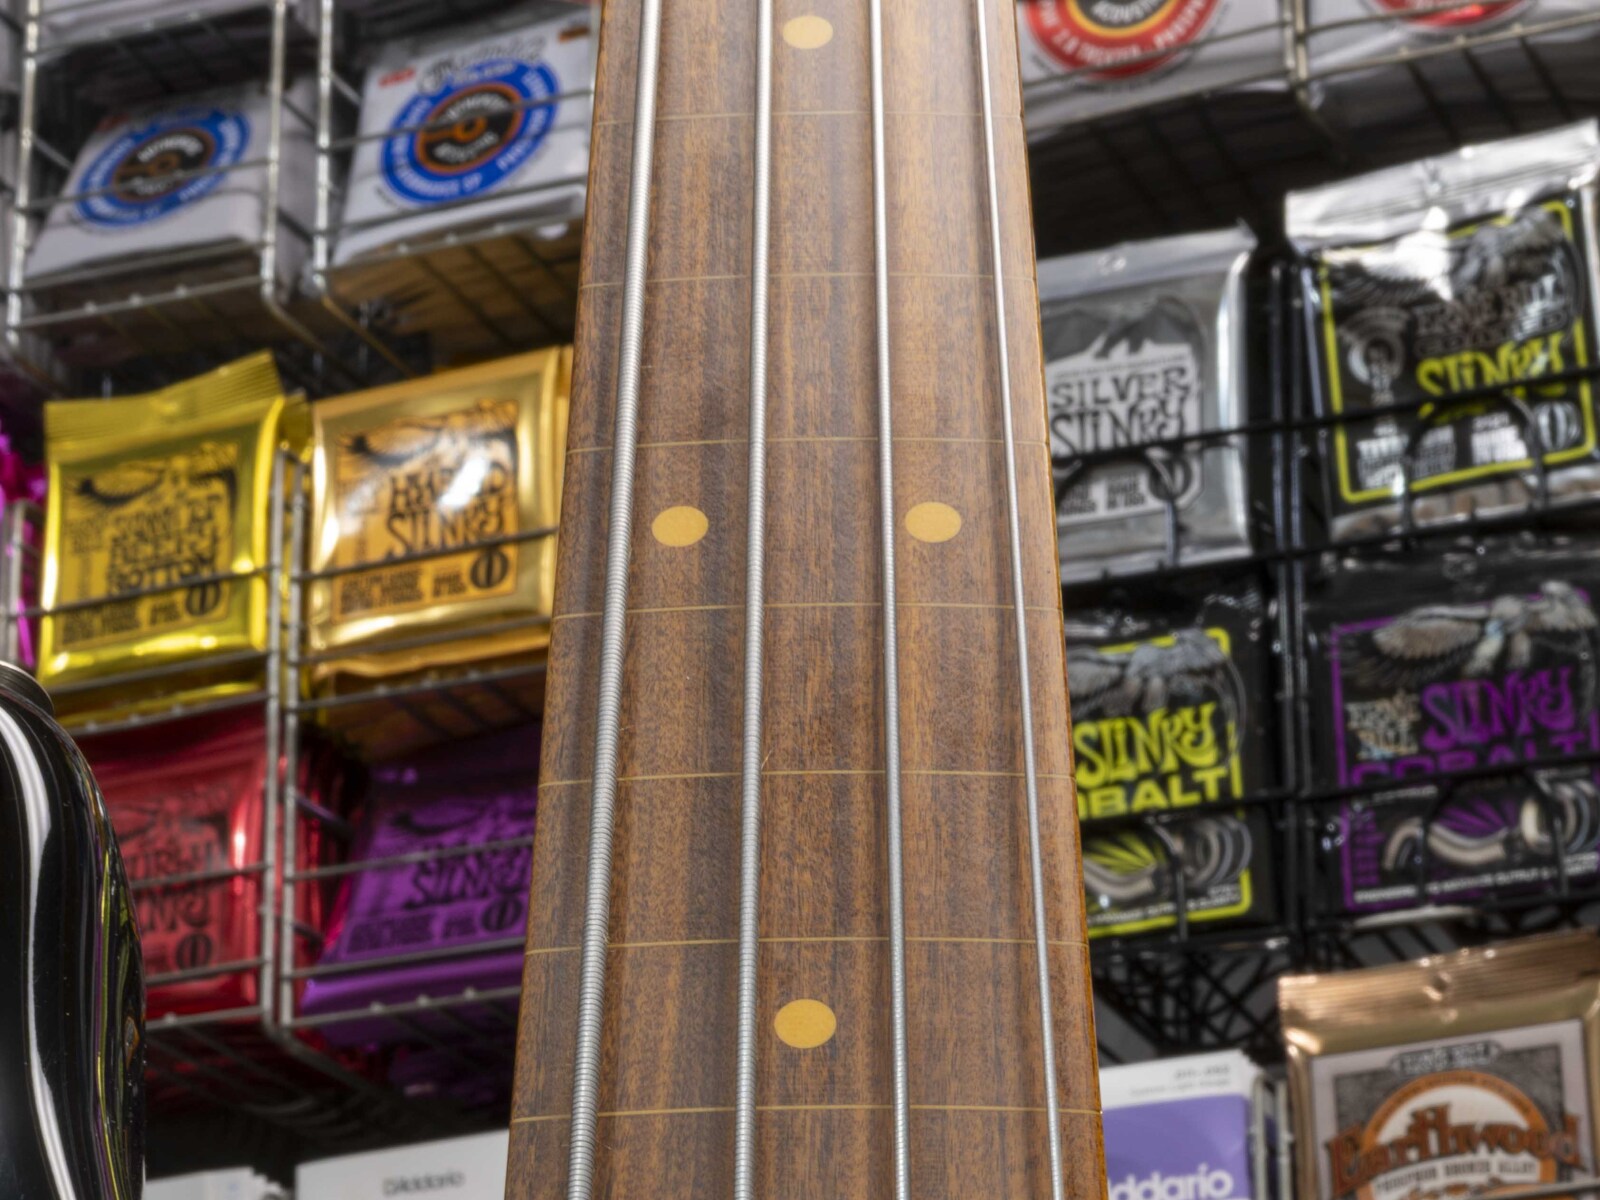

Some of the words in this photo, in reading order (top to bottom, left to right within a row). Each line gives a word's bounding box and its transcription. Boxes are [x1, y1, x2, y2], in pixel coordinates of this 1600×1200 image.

[1052, 366, 1190, 411] SILVER
[1050, 397, 1188, 468] SLINKY
[386, 492, 504, 563] SLINKY
[1422, 665, 1575, 750] SLINKY
[1073, 703, 1219, 789] SLINKY
[1078, 766, 1229, 822] BALT
